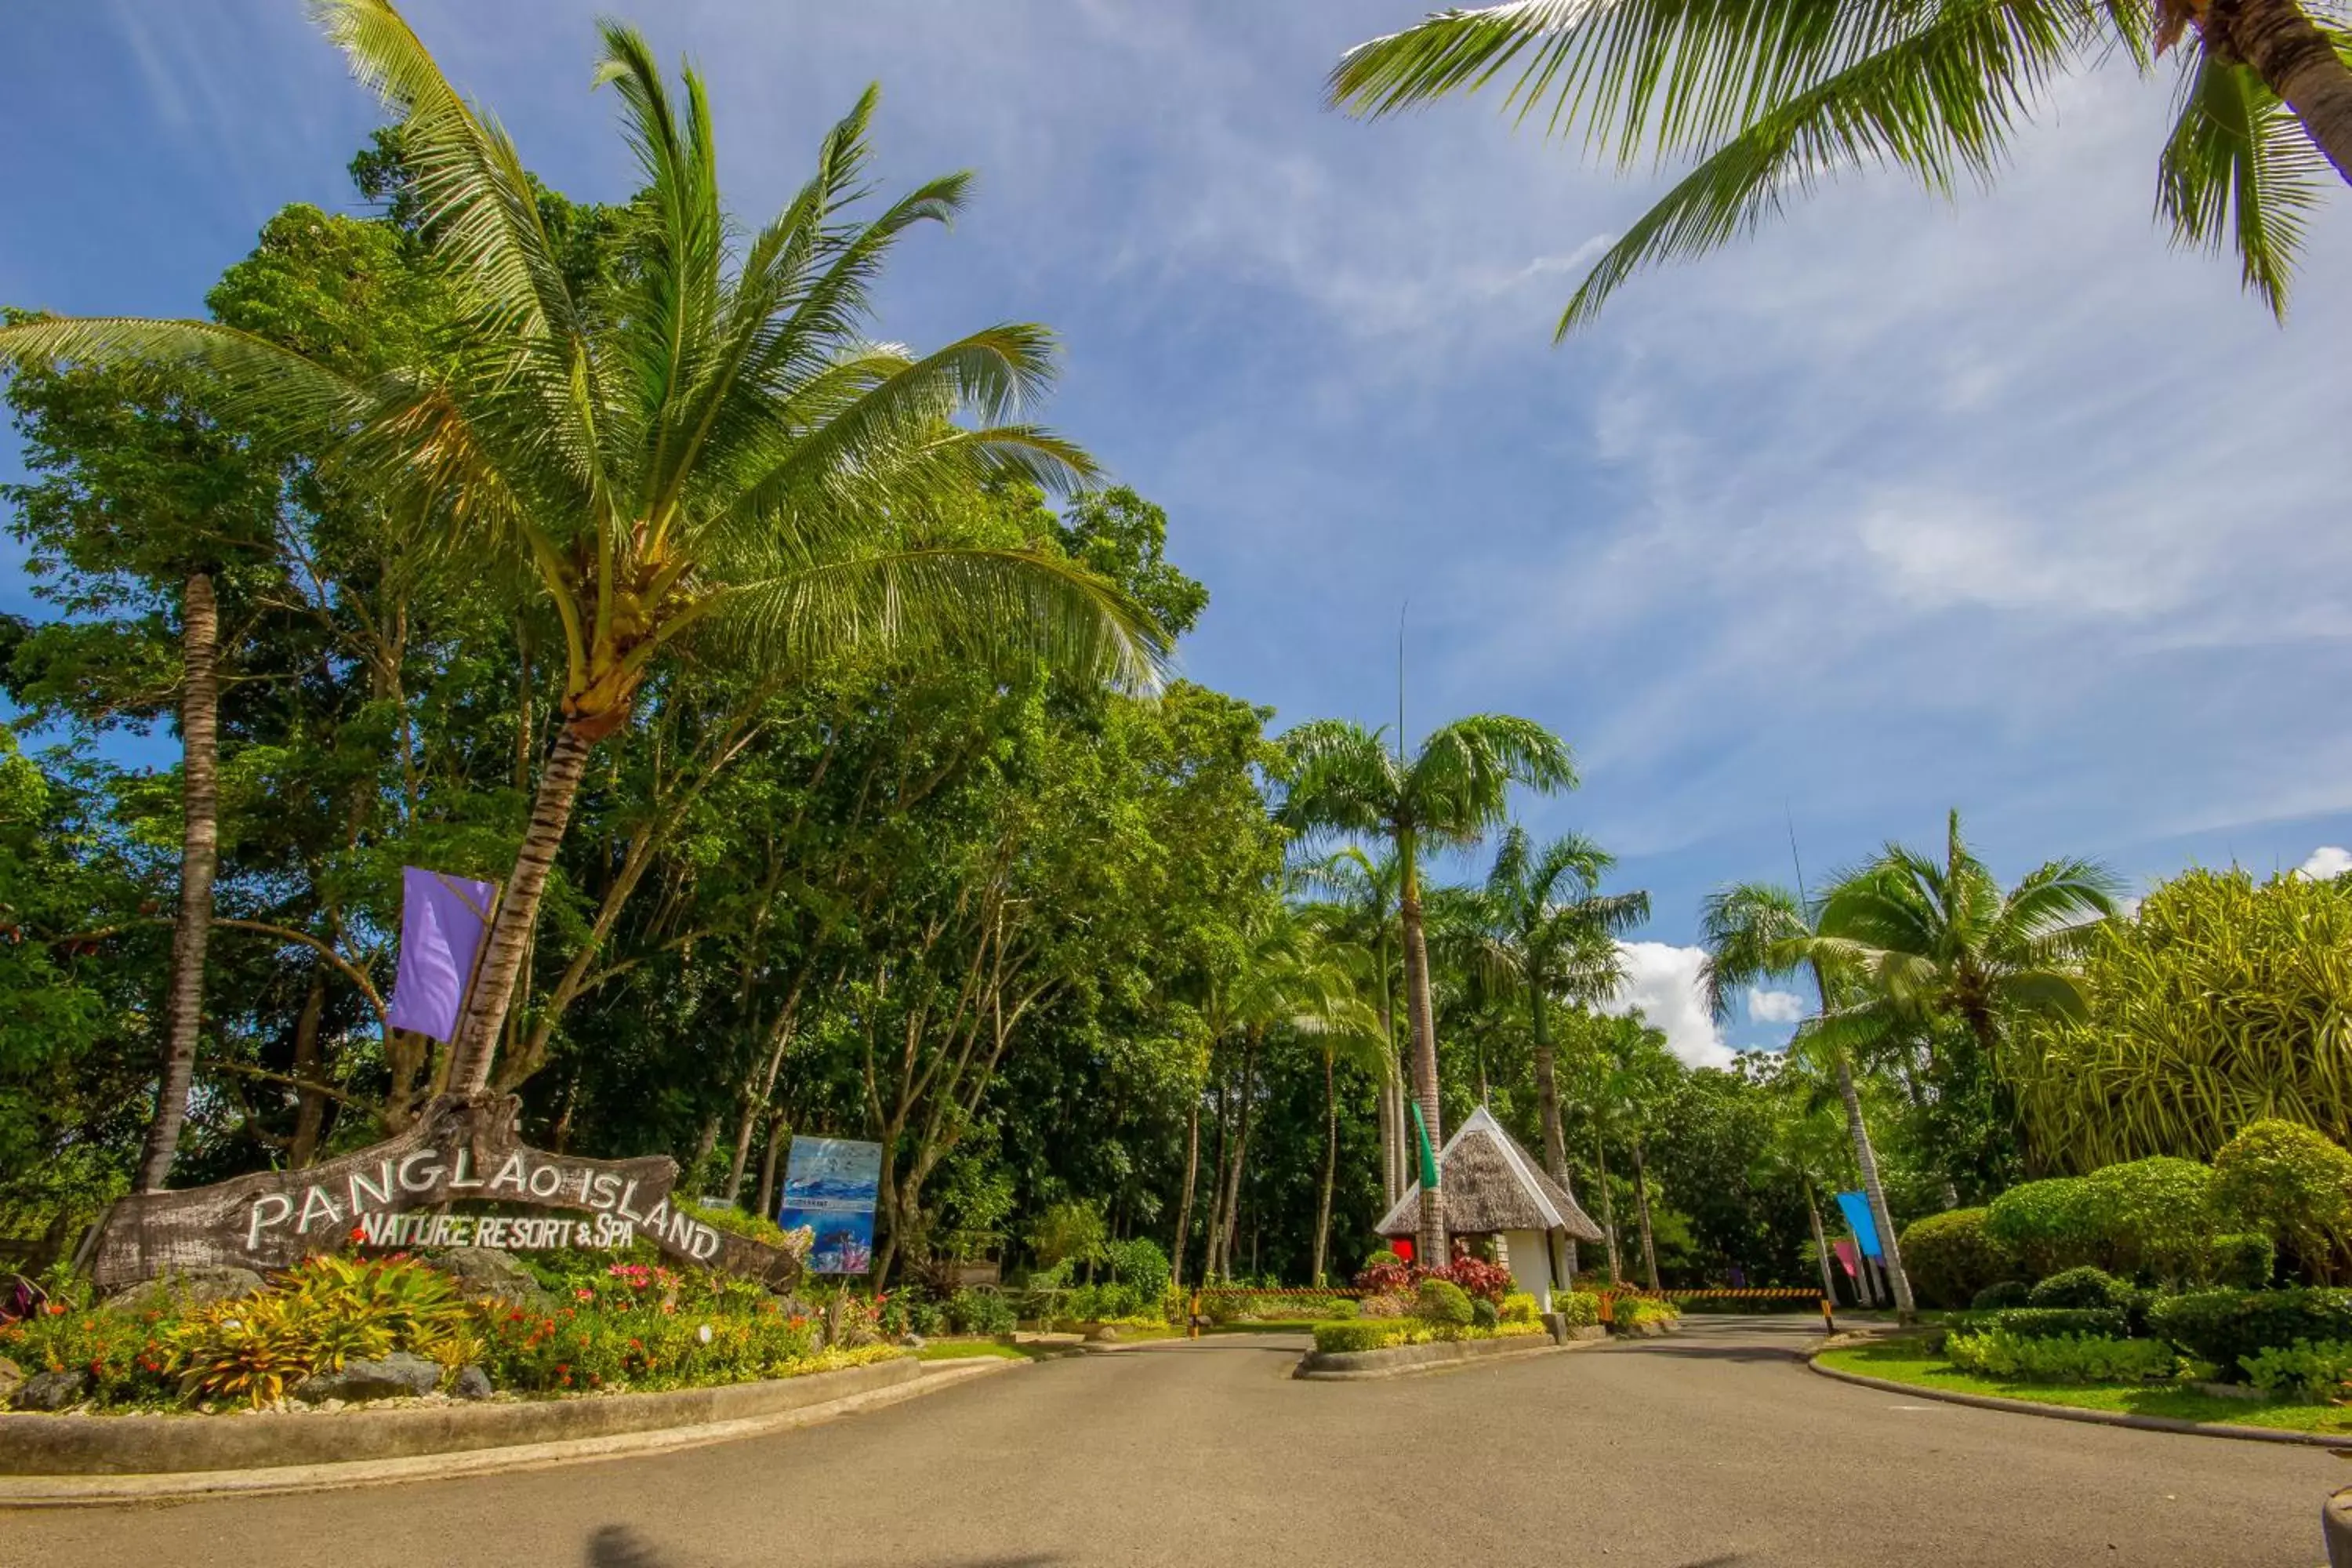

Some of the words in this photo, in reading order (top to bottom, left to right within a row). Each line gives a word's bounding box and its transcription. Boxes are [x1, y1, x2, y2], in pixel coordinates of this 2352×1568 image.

[246, 1148, 561, 1250] PANGLAO
[579, 1168, 719, 1259] ISLAND
[361, 1213, 474, 1246] NATURE
[475, 1216, 575, 1248] RESORT
[577, 1221, 592, 1248] &
[593, 1213, 633, 1248] SPA
